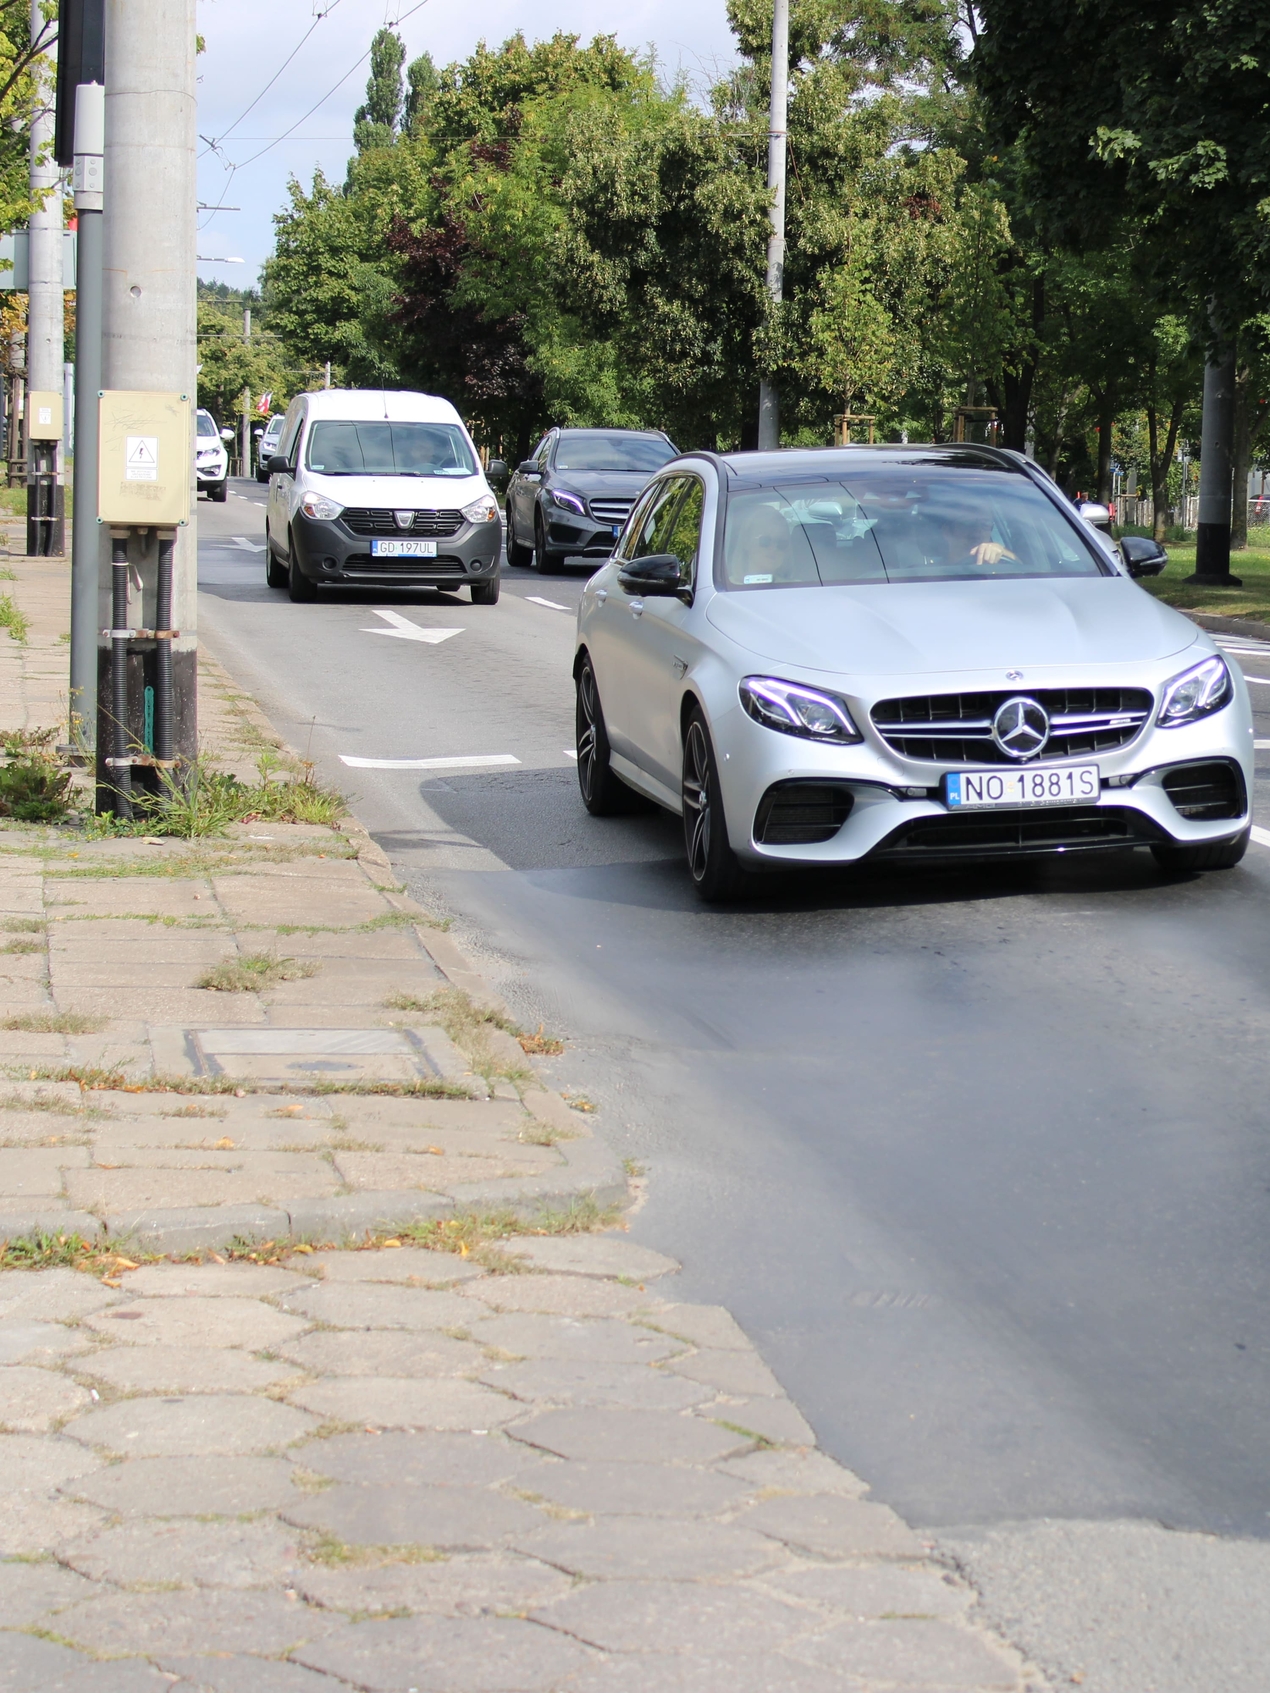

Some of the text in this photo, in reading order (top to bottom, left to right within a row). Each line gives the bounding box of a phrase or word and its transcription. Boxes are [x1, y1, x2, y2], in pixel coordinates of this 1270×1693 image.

[380, 542, 434, 554] GD 197UL
[965, 770, 1094, 801] NO 1881S
[950, 792, 960, 800] PL
